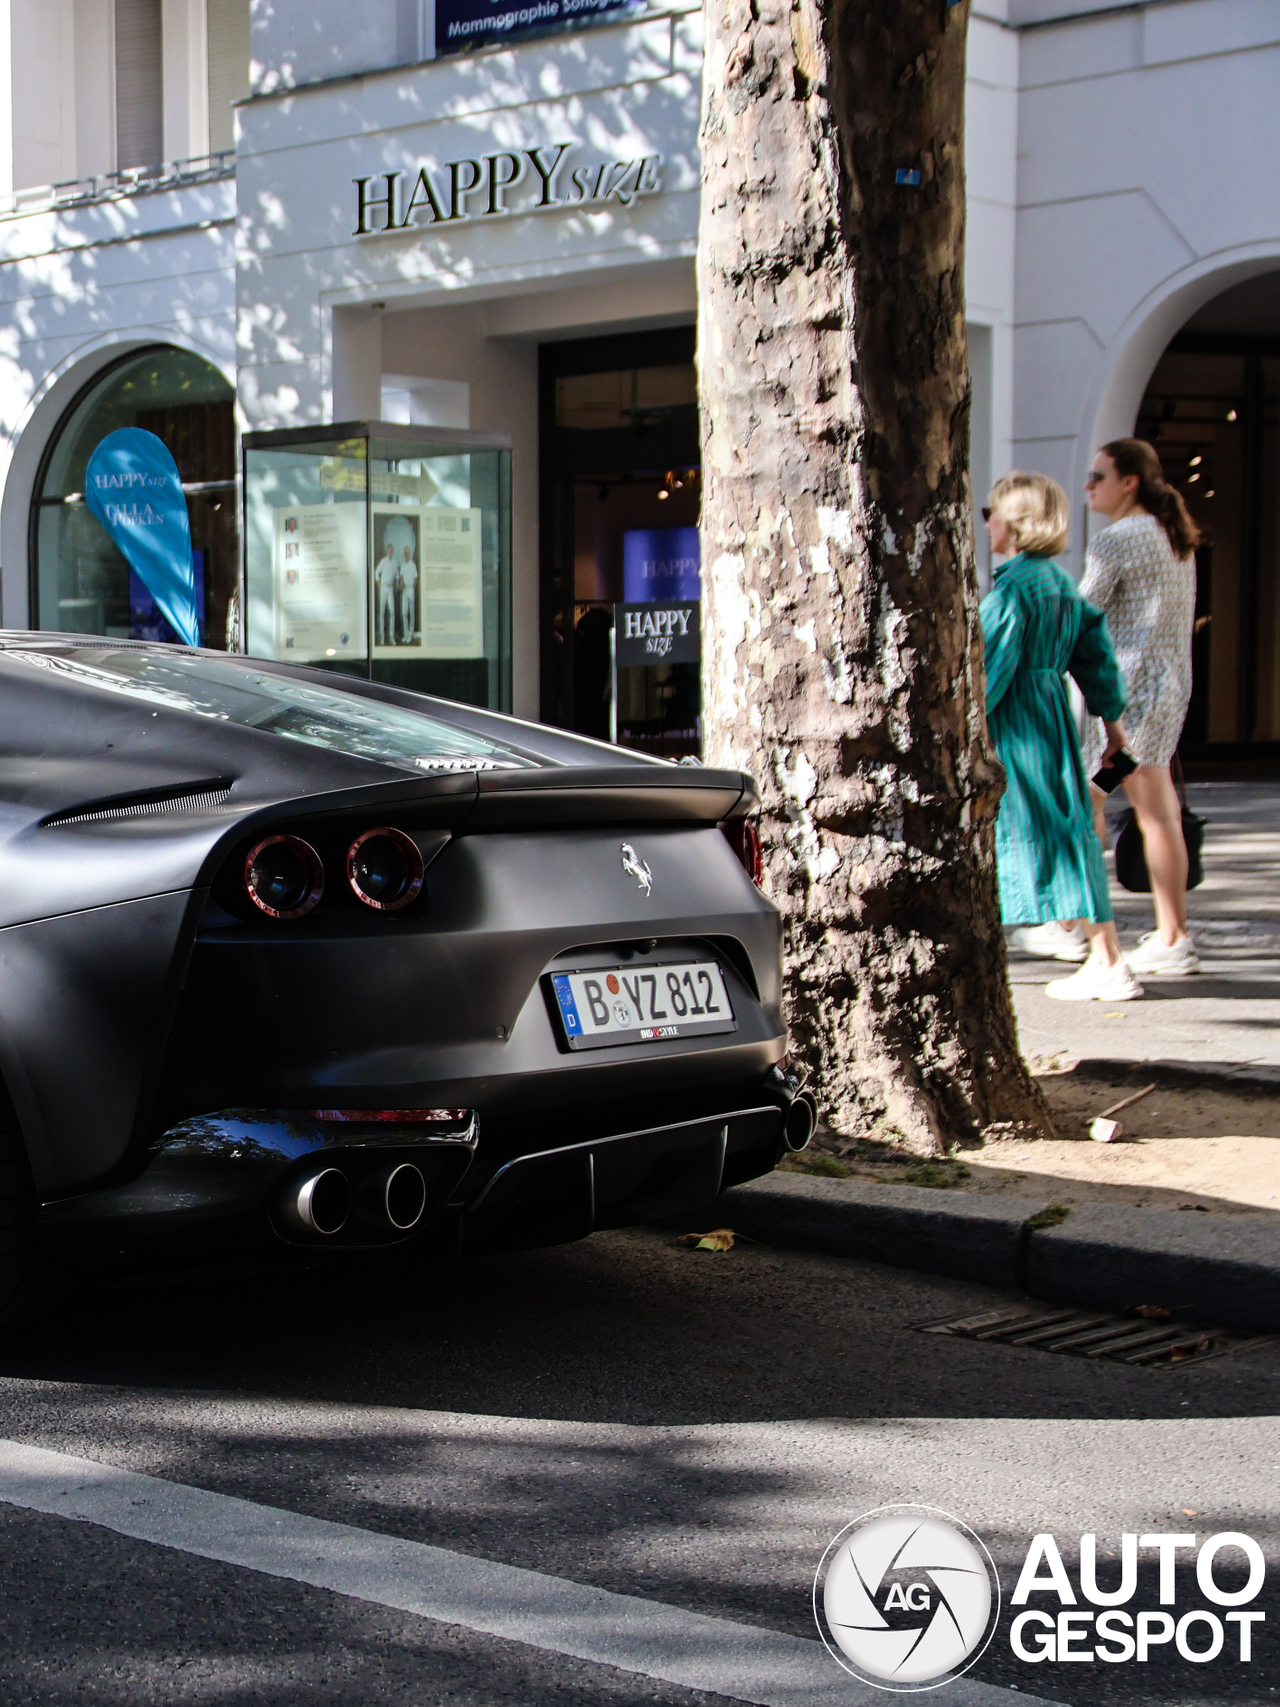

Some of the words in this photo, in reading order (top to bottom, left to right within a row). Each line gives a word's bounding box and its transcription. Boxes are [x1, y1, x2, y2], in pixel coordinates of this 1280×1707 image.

[447, 1, 559, 38] Mammographie
[352, 142, 573, 236] HAPPY
[94, 472, 149, 489] HAPPY
[624, 609, 693, 638] HAPPY
[646, 636, 674, 657] SIZE
[582, 979, 610, 1027] B
[621, 974, 668, 1021] YZ
[665, 970, 721, 1017] 812
[566, 1013, 578, 1029] D
